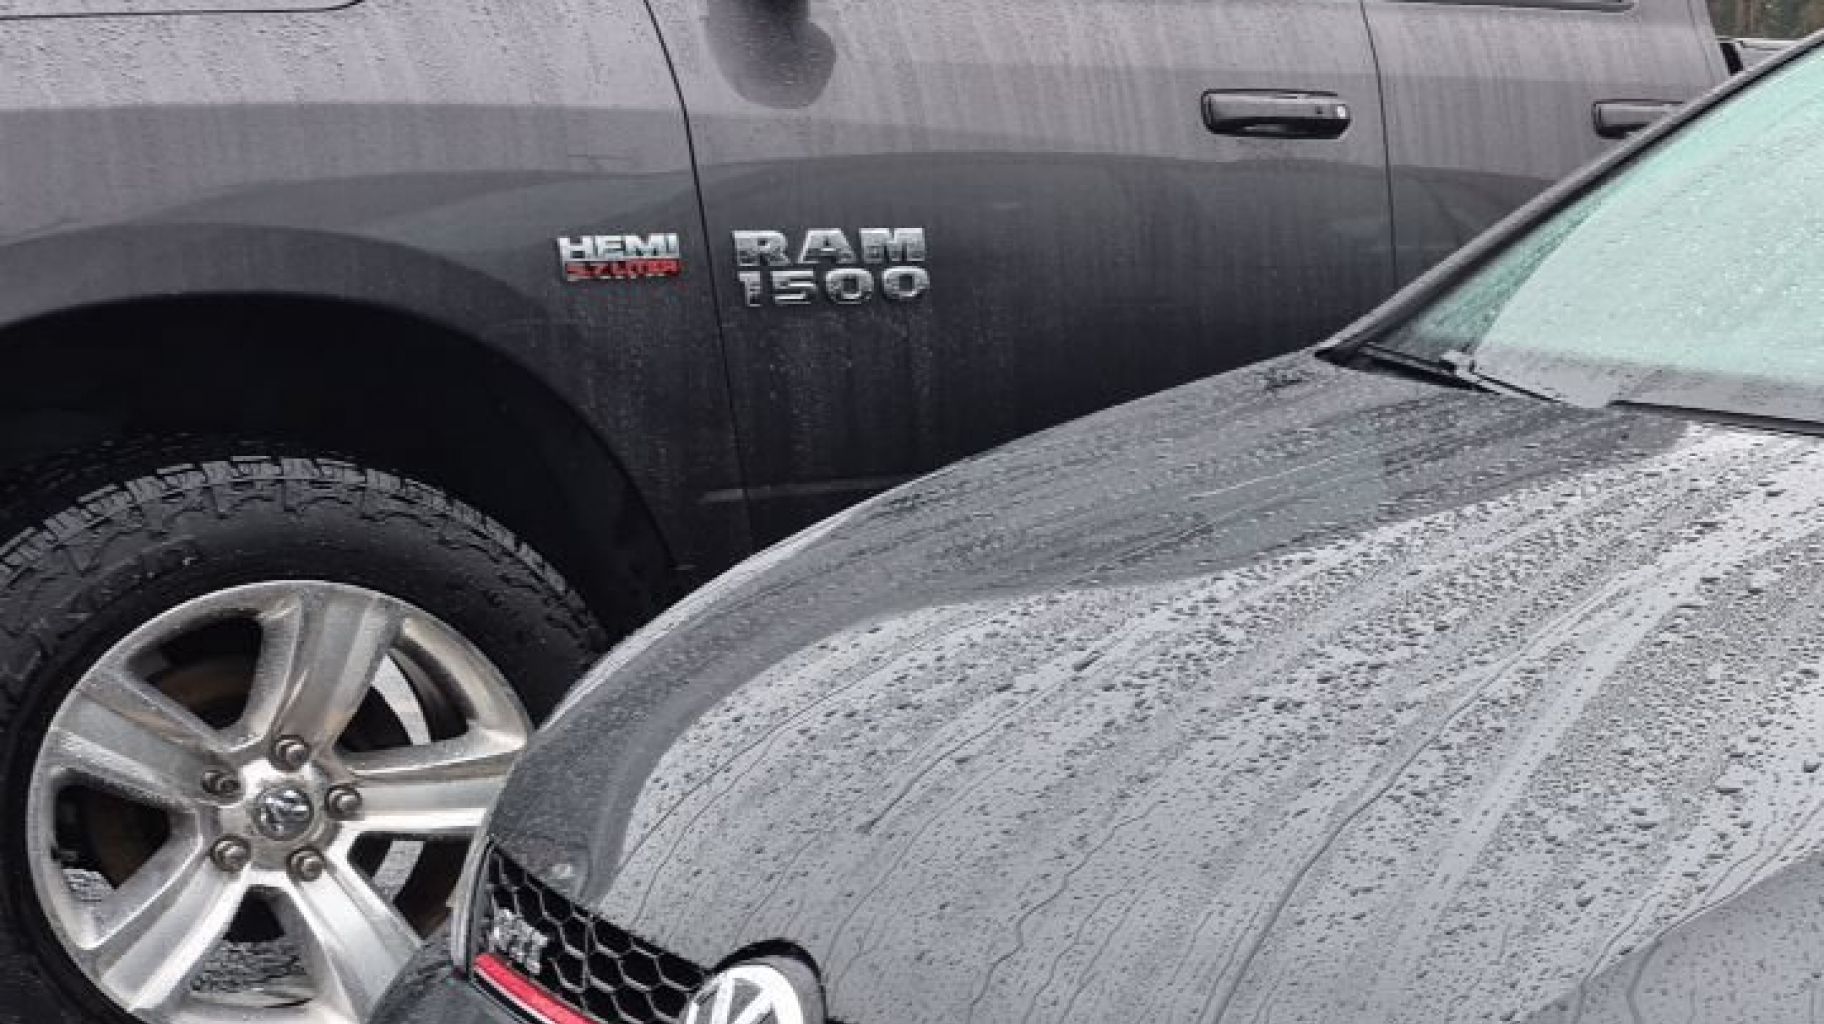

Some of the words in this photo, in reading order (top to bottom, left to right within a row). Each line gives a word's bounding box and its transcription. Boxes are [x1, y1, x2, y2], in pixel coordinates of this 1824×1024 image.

[557, 232, 680, 261] HEMI
[731, 227, 926, 266] RAM
[738, 266, 930, 307] 1500
